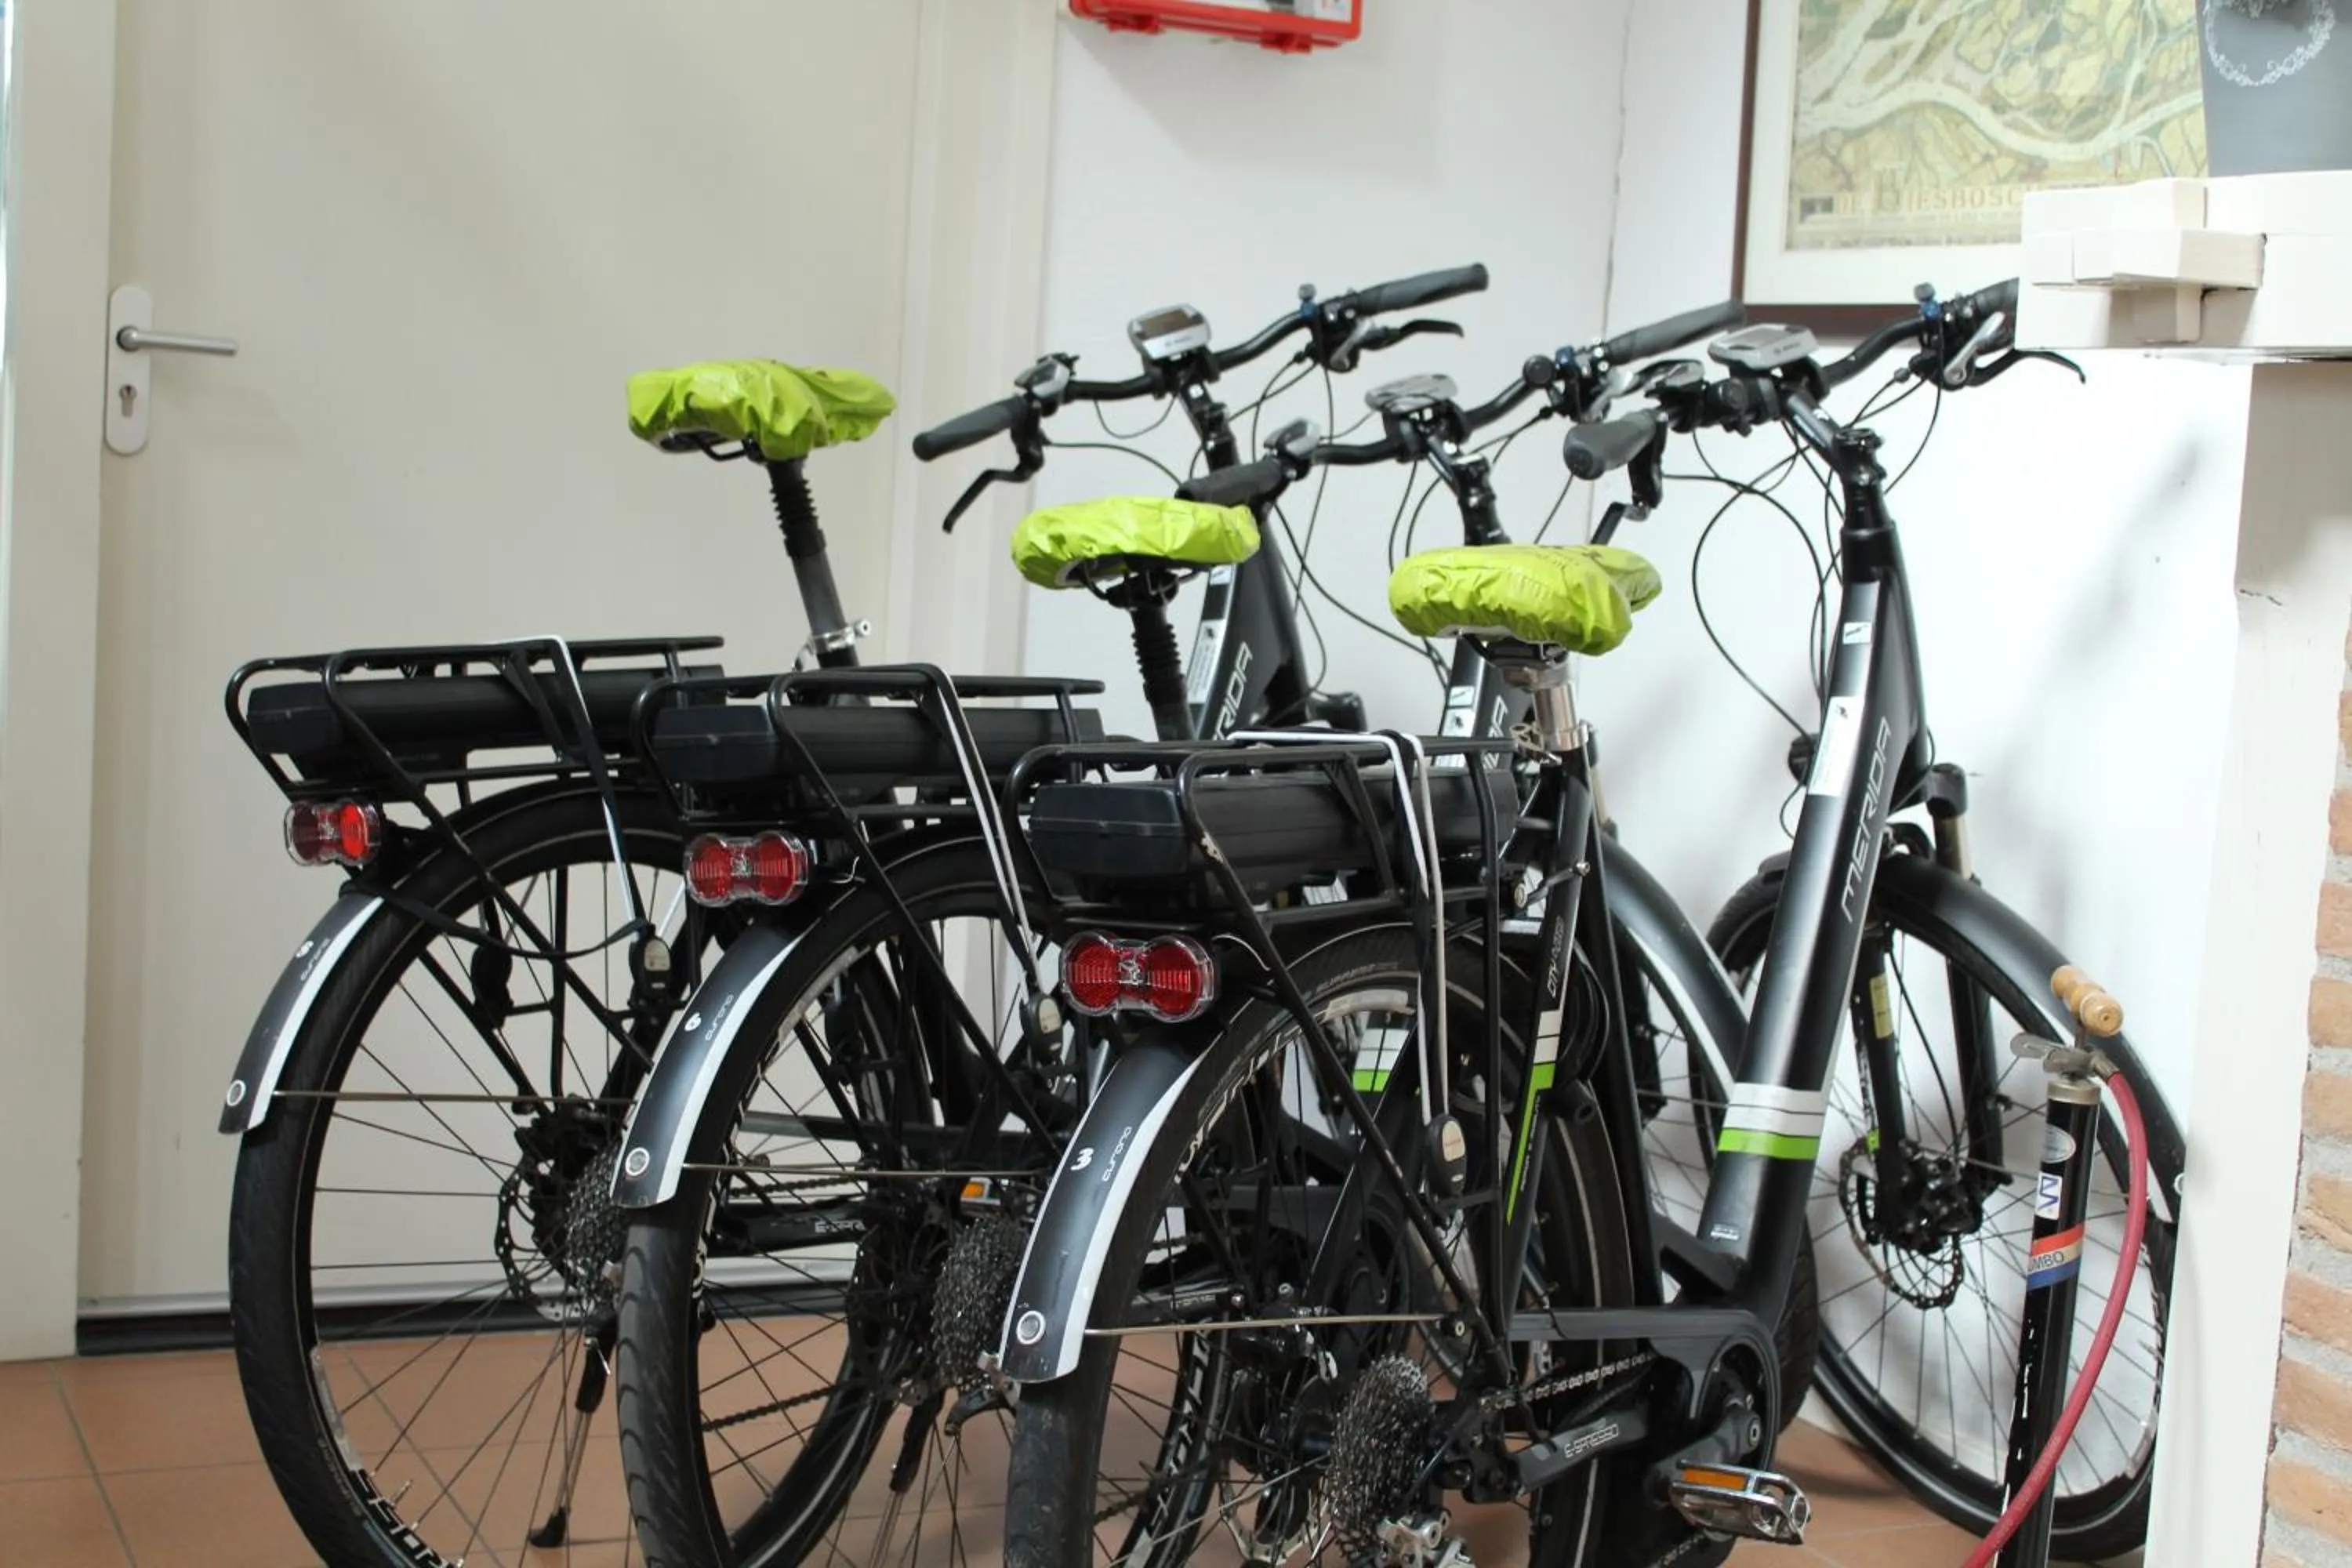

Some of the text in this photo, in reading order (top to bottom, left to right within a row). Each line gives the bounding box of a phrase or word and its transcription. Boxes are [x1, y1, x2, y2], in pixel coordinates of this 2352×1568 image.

[1872, 168, 2042, 214] BIESBOSC
[1841, 716, 1892, 924] MERIDA
[2029, 1250, 2065, 1272] MBO
